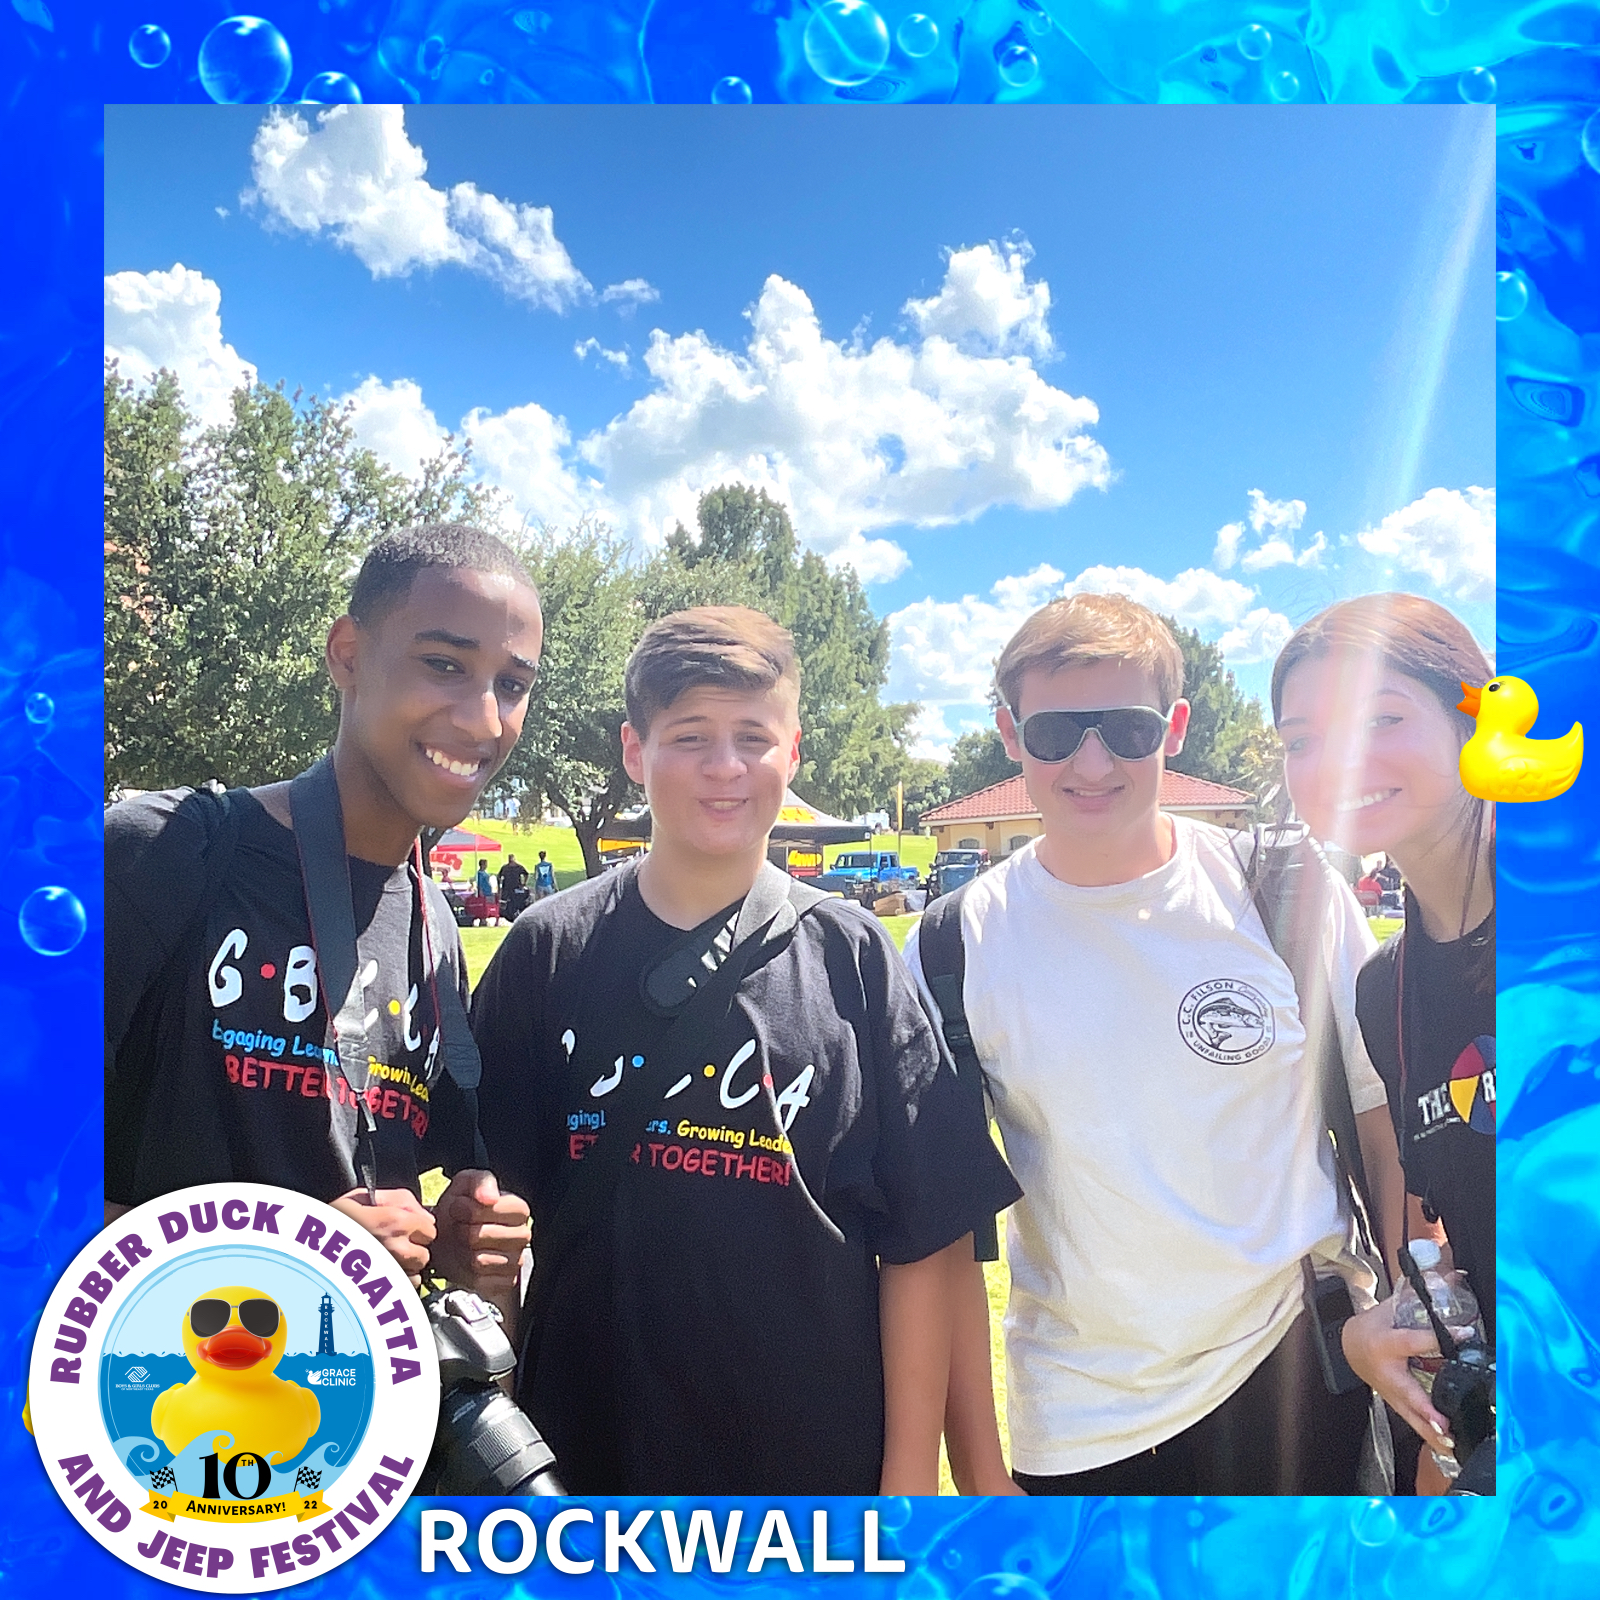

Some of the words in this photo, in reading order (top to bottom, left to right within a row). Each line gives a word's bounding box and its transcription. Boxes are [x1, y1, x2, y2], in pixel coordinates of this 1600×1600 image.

[1191, 982, 1234, 1001] FILSON
[1193, 1040, 1242, 1061] UNFAILING
[677, 1119, 745, 1149] Growing
[648, 1142, 792, 1186] TOGETHER!
